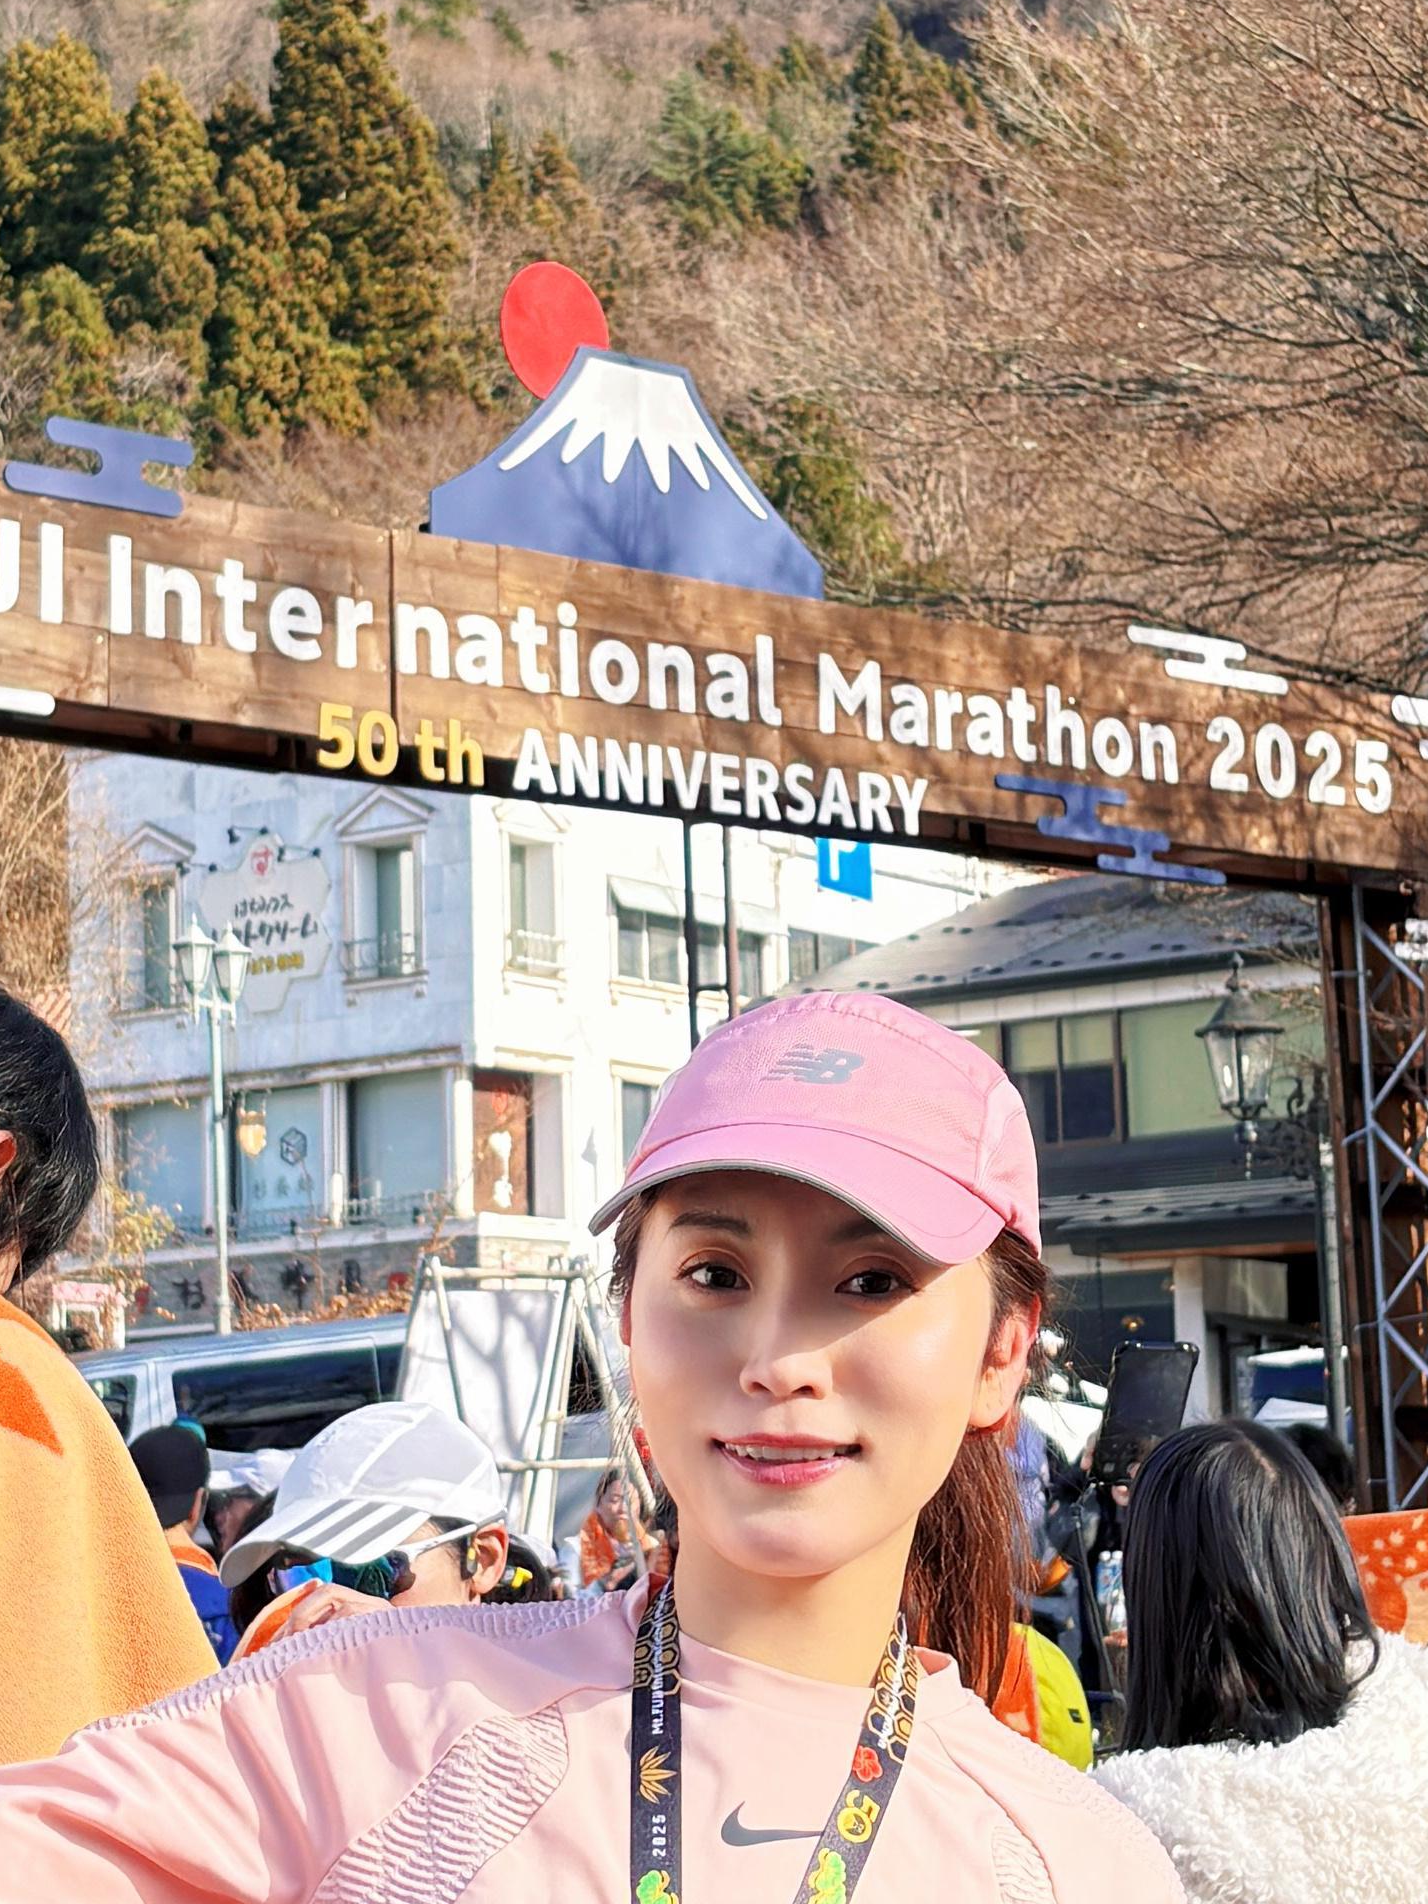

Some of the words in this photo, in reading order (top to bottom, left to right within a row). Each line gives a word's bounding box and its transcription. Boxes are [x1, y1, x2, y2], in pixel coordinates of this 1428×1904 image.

[109, 534, 782, 727] International
[818, 652, 1178, 784] Marathon
[1206, 715, 1394, 815] 2025
[513, 728, 928, 836] ANNIVERSARY
[652, 1814, 667, 1857] 2025
